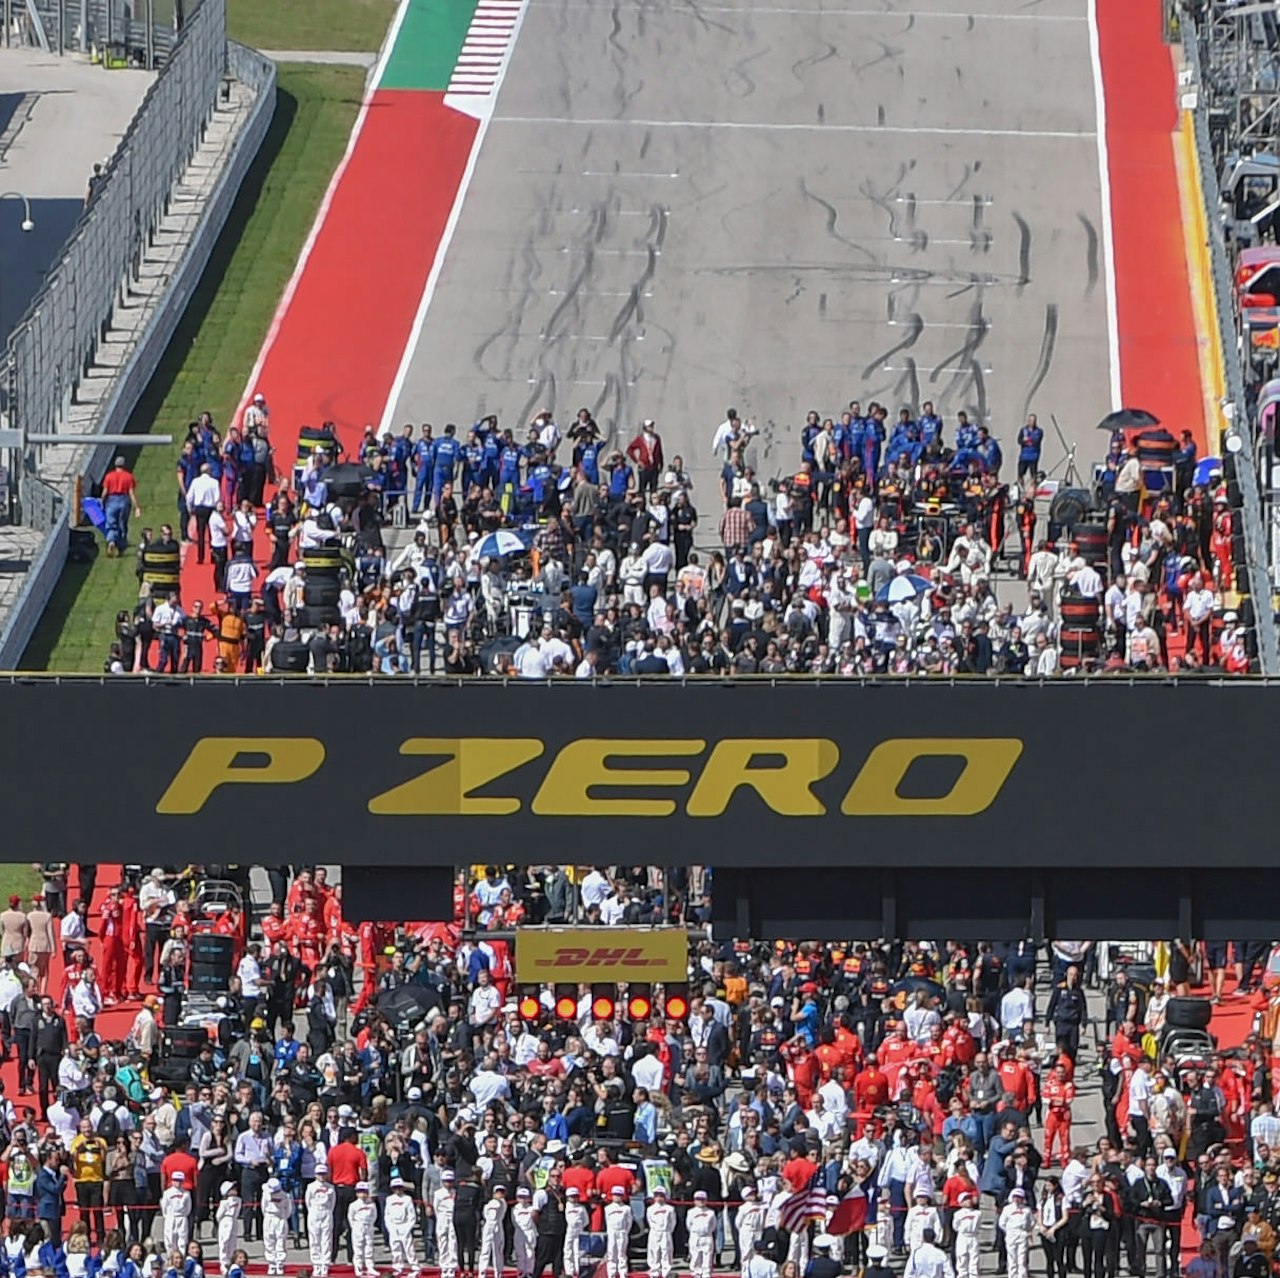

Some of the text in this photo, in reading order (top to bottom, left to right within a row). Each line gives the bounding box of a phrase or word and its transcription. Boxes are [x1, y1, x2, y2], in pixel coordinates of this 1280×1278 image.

[156, 737, 1024, 817] P ZERO
[553, 948, 649, 967] DHL
